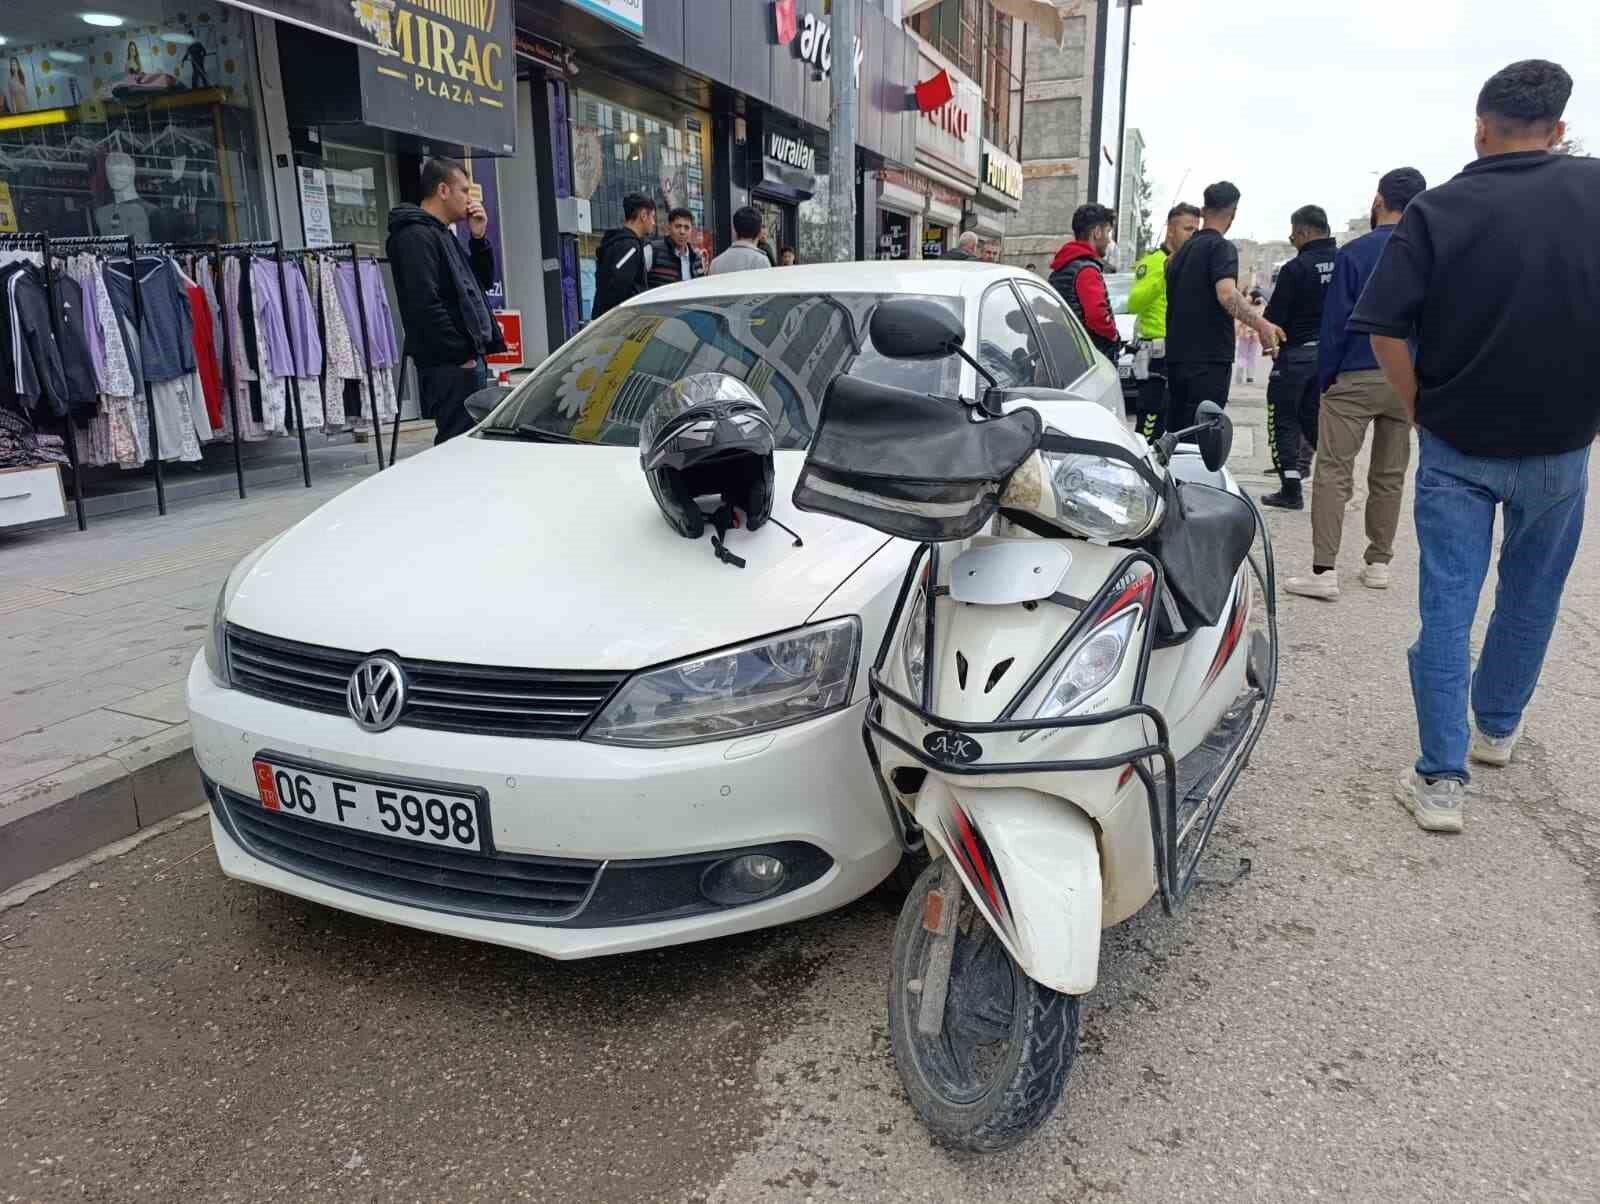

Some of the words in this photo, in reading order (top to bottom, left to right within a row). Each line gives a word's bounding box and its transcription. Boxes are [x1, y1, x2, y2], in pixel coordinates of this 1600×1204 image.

[414, 72, 475, 106] PLAZA
[274, 769, 316, 815] 06
[332, 782, 358, 822] F
[375, 789, 476, 845] 5998
